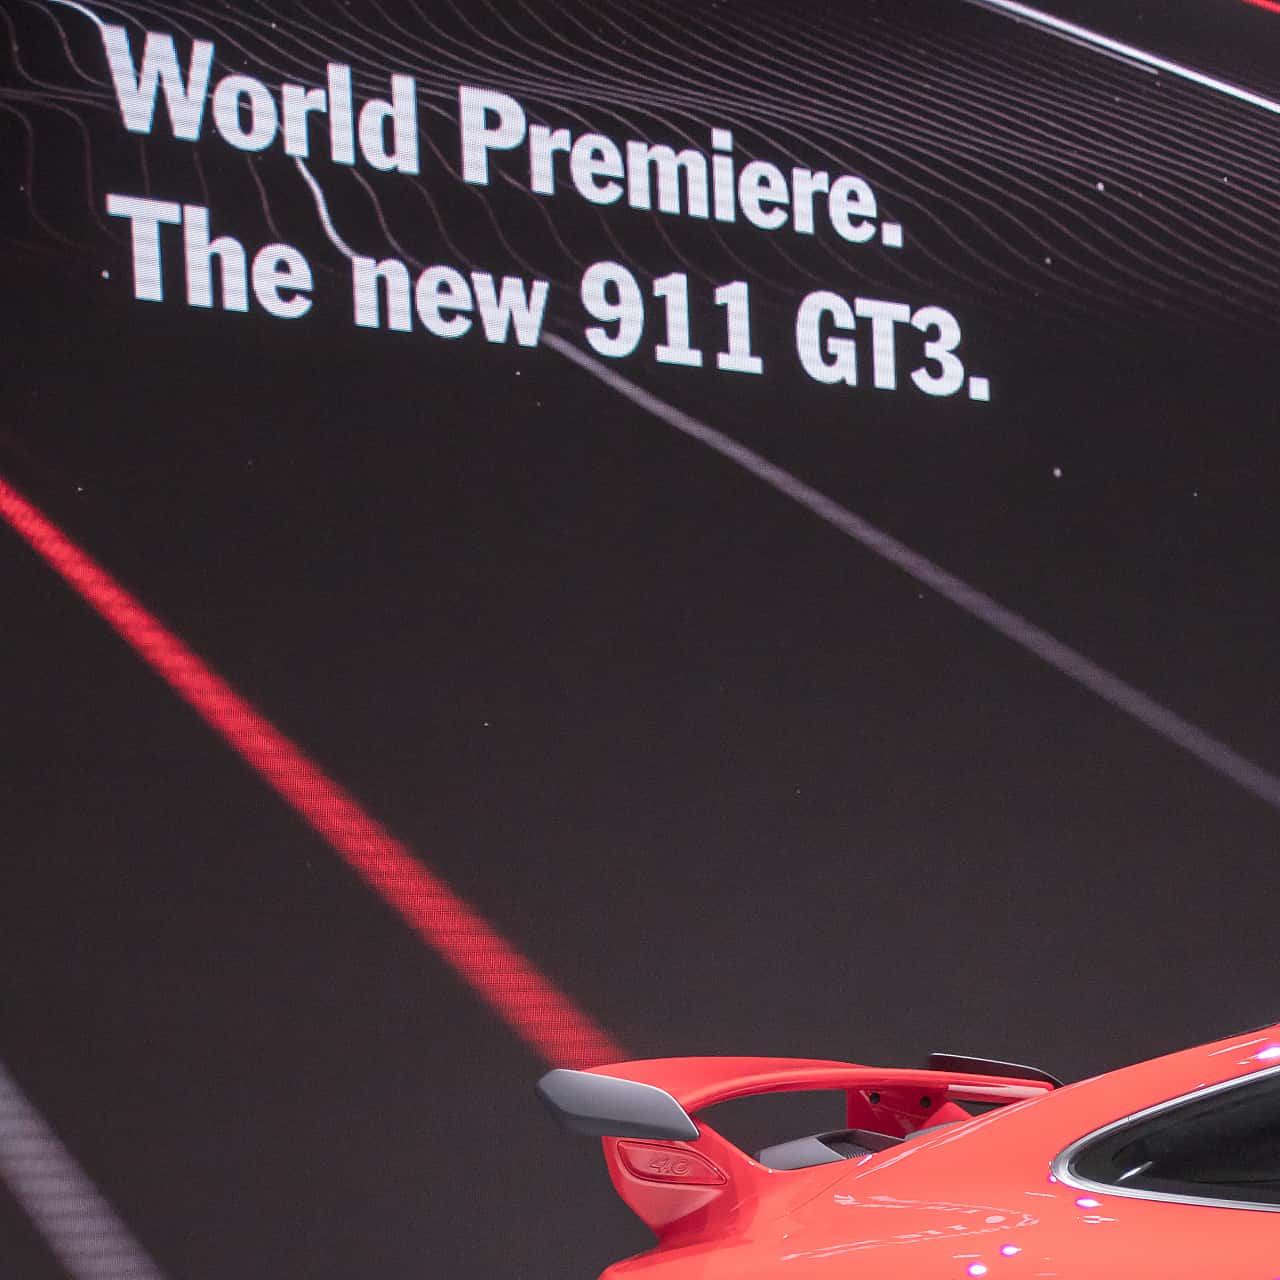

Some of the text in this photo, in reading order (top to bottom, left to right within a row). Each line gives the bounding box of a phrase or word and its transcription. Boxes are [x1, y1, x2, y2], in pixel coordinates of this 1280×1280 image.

[102, 23, 903, 248] World Premiere.
[107, 194, 990, 402] The new 911 GT3.
